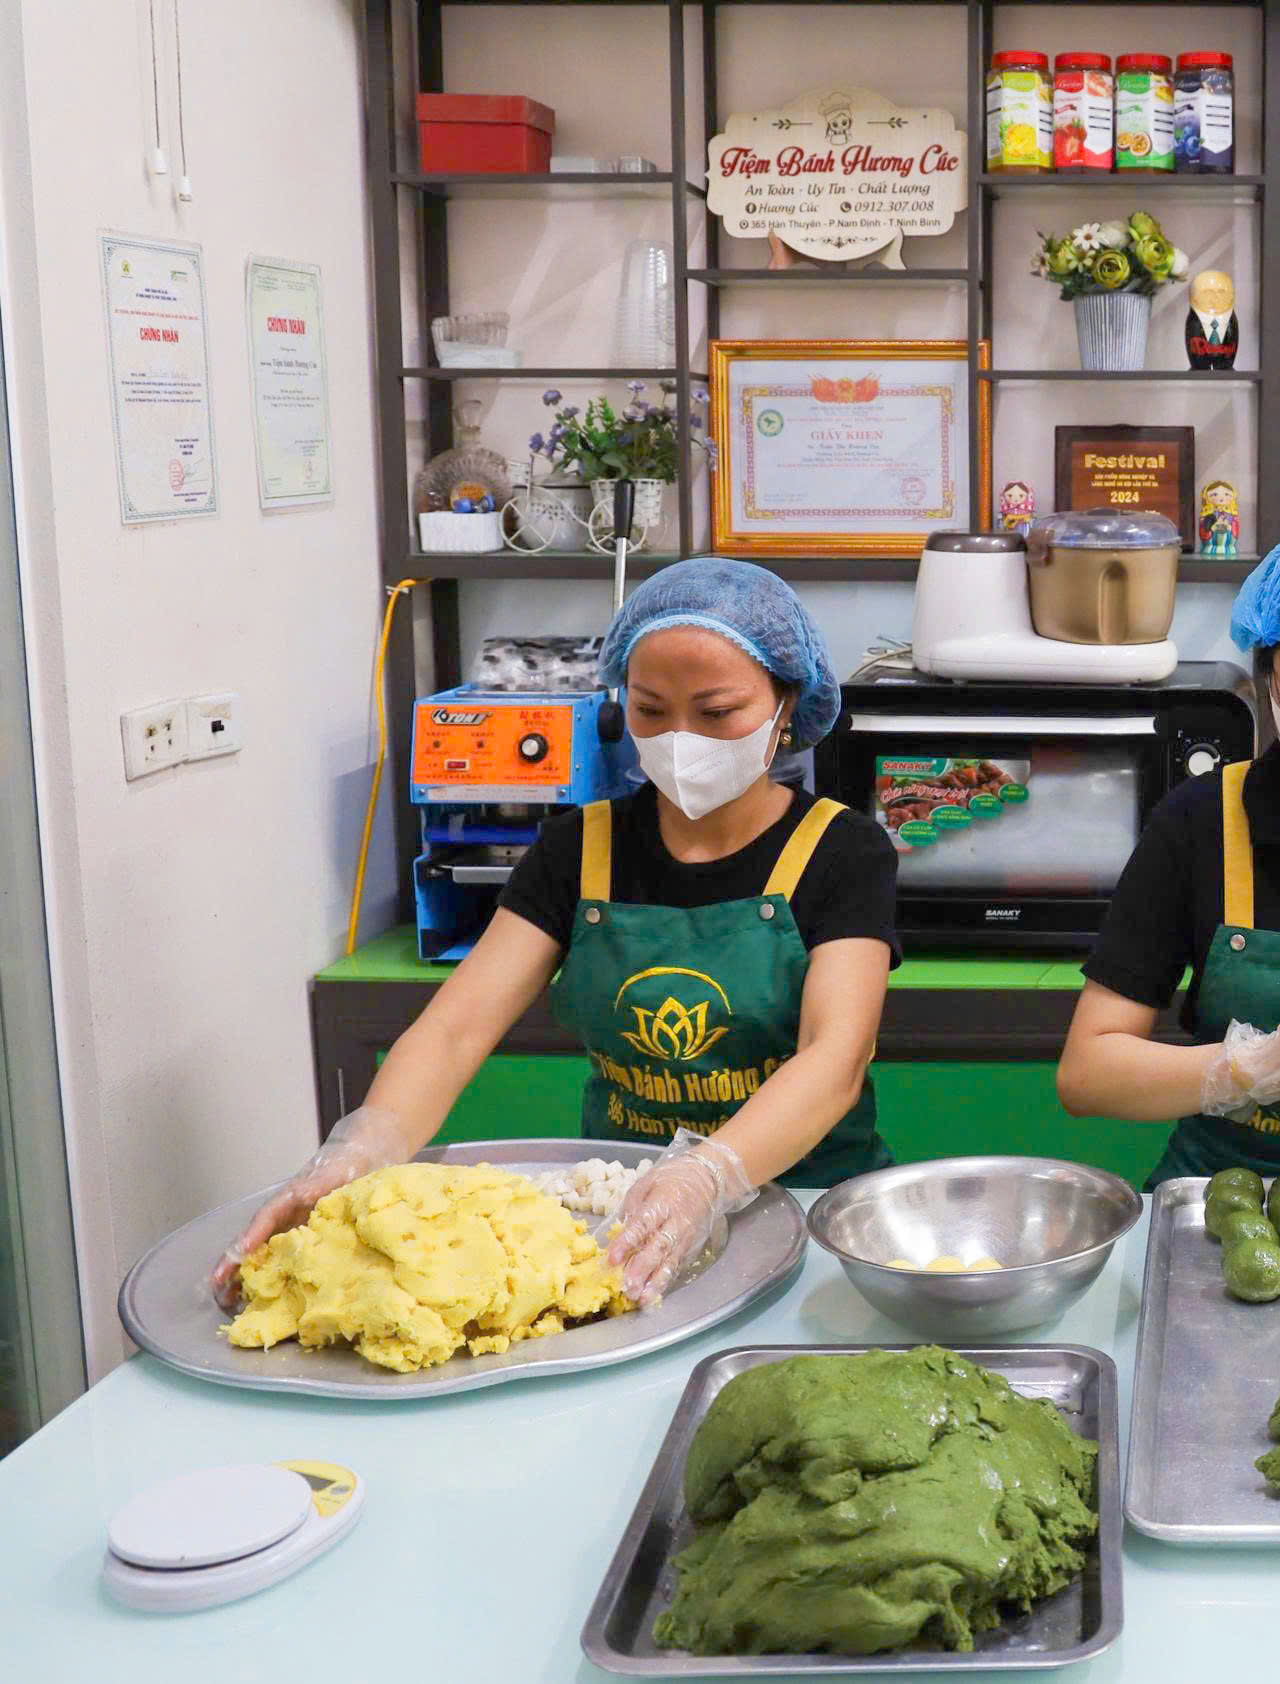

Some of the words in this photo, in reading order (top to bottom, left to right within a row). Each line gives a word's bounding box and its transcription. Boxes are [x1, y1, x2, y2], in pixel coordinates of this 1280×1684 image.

[720, 147, 771, 179] Tiệm
[776, 146, 836, 176] Bánh
[841, 145, 914, 178] Hương
[919, 144, 960, 175] Cúc
[745, 184, 763, 196] An
[768, 183, 794, 196] Toàn
[807, 183, 824, 197] Uy
[854, 201, 935, 212] 0912.307.008
[1084, 454, 1166, 469] Festival
[1110, 491, 1140, 503] 2024
[985, 909, 1021, 917] SANAKY
[684, 1067, 760, 1103] Hương
